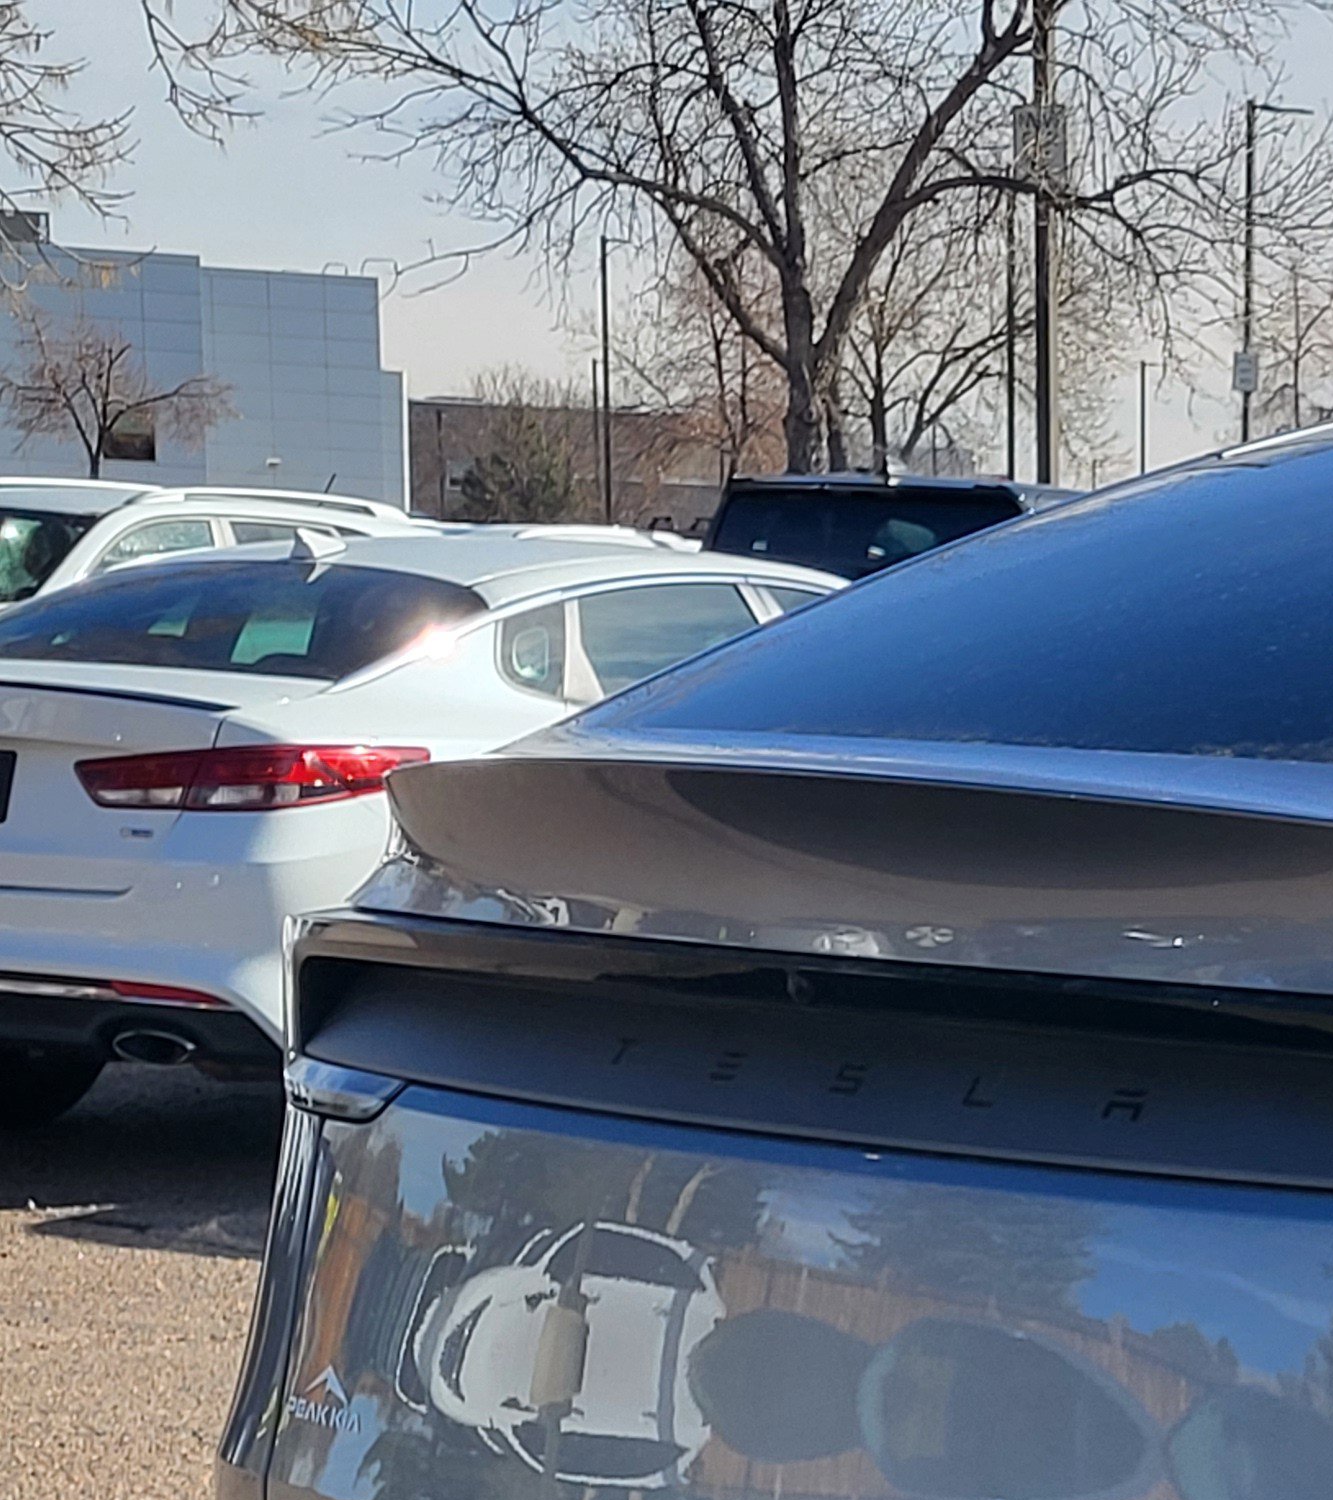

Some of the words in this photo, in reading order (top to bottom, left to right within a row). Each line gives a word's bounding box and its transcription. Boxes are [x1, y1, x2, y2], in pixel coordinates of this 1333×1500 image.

[610, 1037, 1148, 1122] TESLA
[288, 1395, 329, 1427] PEAK
[329, 1405, 361, 1435] KIA
